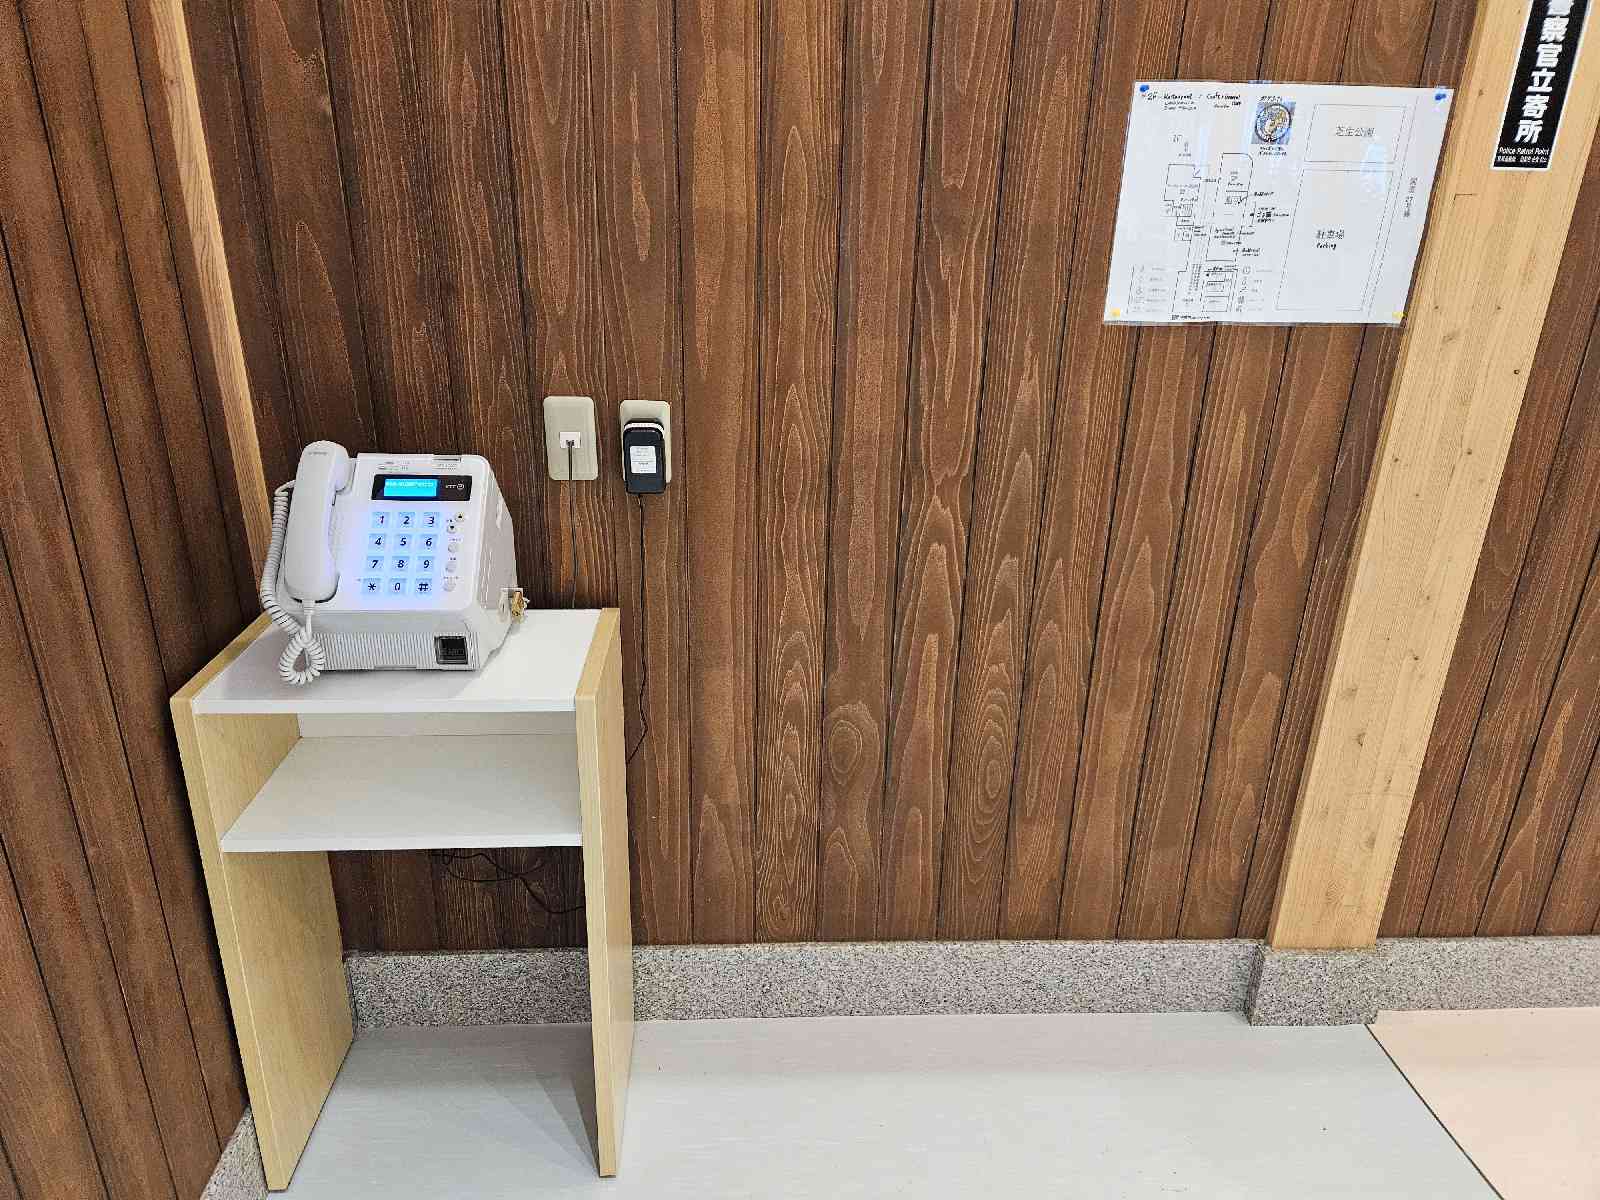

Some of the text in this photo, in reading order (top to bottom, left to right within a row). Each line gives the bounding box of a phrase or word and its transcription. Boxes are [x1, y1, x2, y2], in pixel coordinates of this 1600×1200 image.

[1499, 146, 1550, 156] Police Patrol Point
[379, 515, 435, 525] 1 2 3
[374, 536, 432, 547] 4 5 6
[371, 560, 430, 569] 7 8 9
[394, 582, 401, 592] 0
